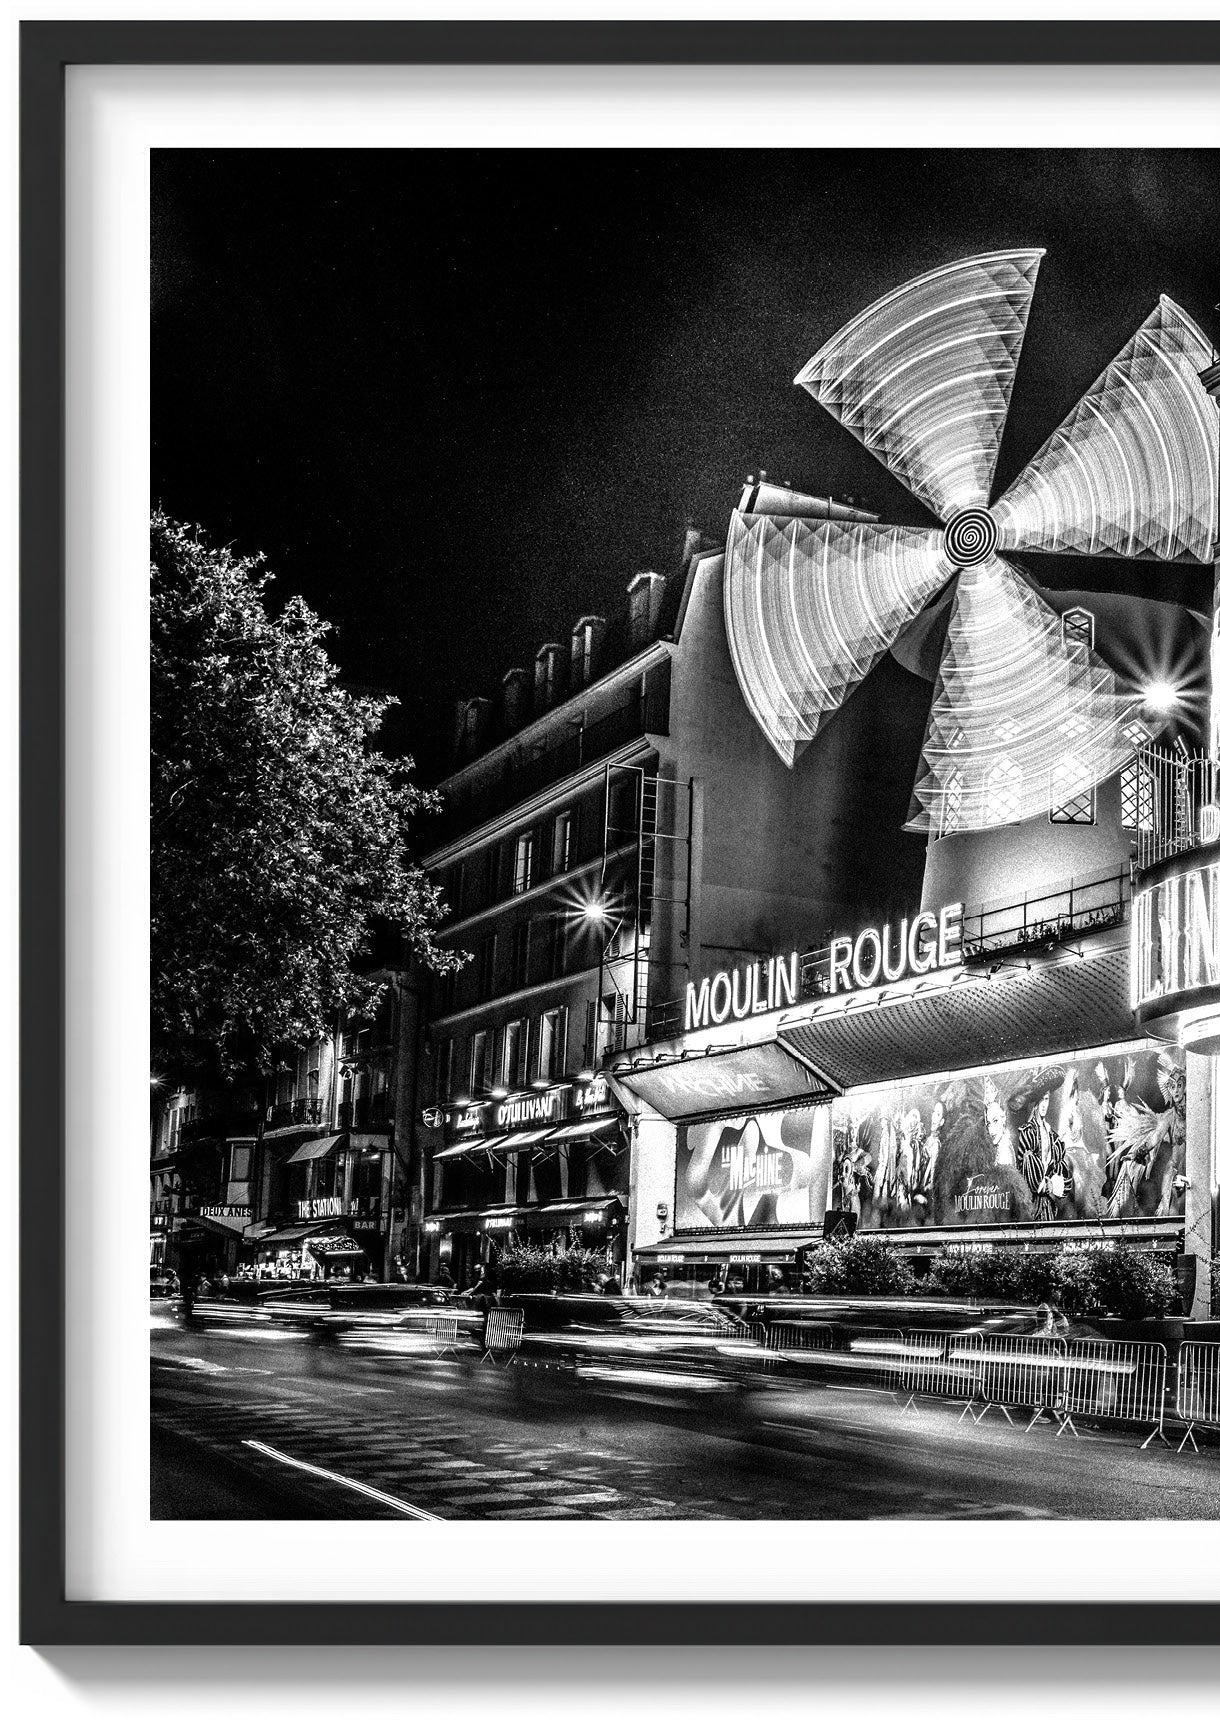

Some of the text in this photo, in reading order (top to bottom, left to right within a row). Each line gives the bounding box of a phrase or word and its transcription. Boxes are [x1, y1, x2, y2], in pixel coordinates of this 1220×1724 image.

[684, 902, 966, 1032] MOULIN ROUGE
[954, 1191, 1011, 1213] MOULIN ROUGE
[203, 1206, 224, 1217] DEUX
[354, 1221, 375, 1229] BAR
